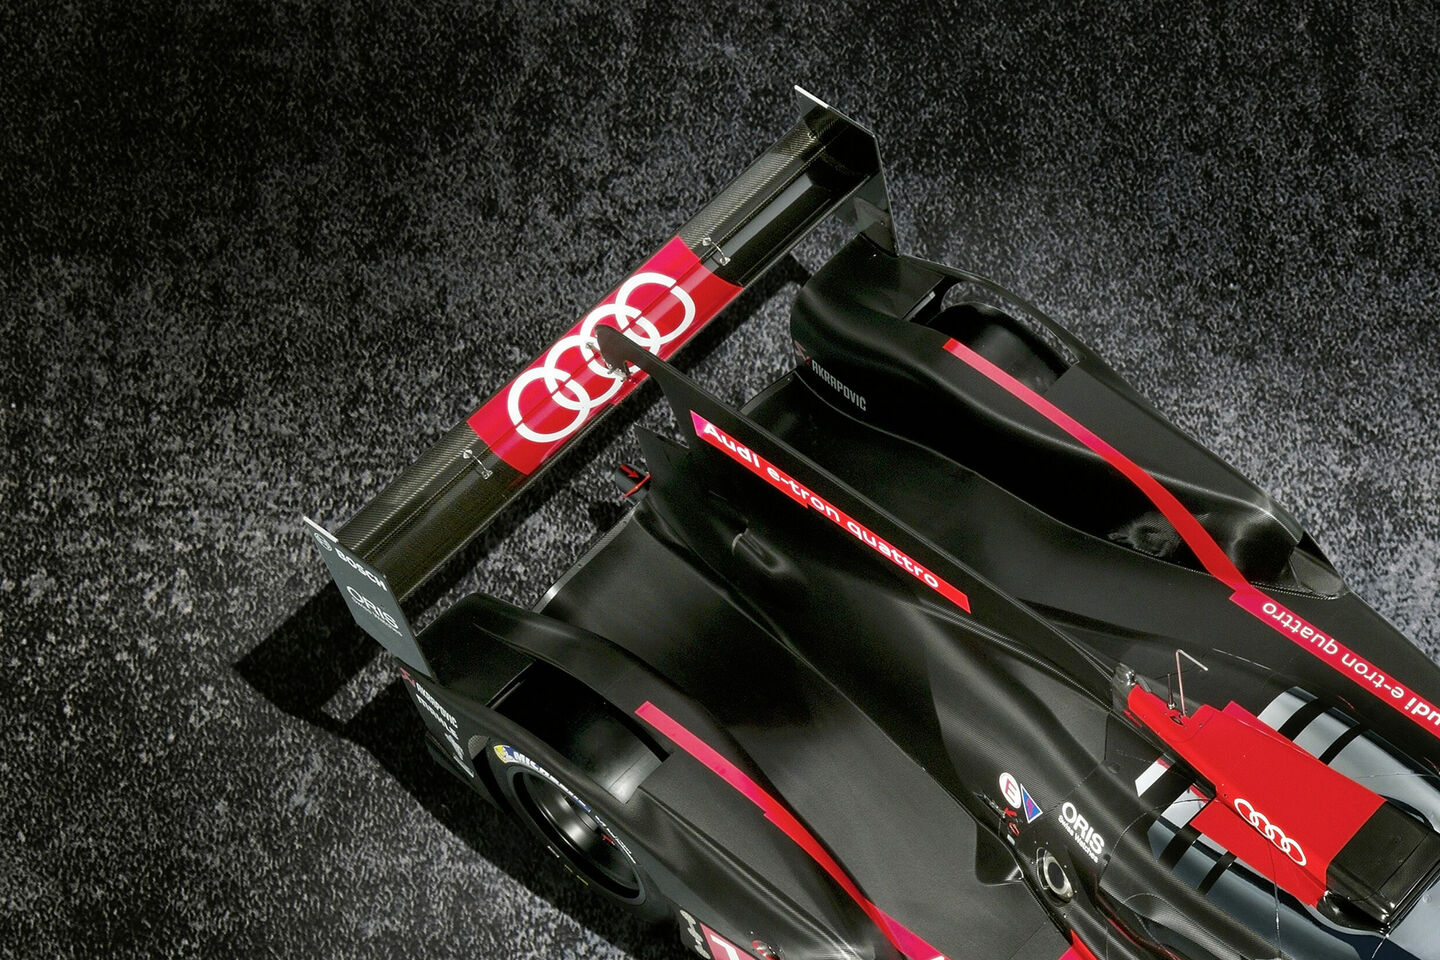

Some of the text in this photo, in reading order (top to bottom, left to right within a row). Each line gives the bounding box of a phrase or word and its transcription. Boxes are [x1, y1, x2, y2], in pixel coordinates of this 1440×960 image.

[703, 421, 939, 589] Audi e-tron quattro
[335, 547, 388, 592] BOSCH
[347, 586, 399, 629] ORIS
[1262, 602, 1339, 655] quattro
[1341, 653, 1405, 699] e-tron
[1061, 801, 1105, 855] ORIS
